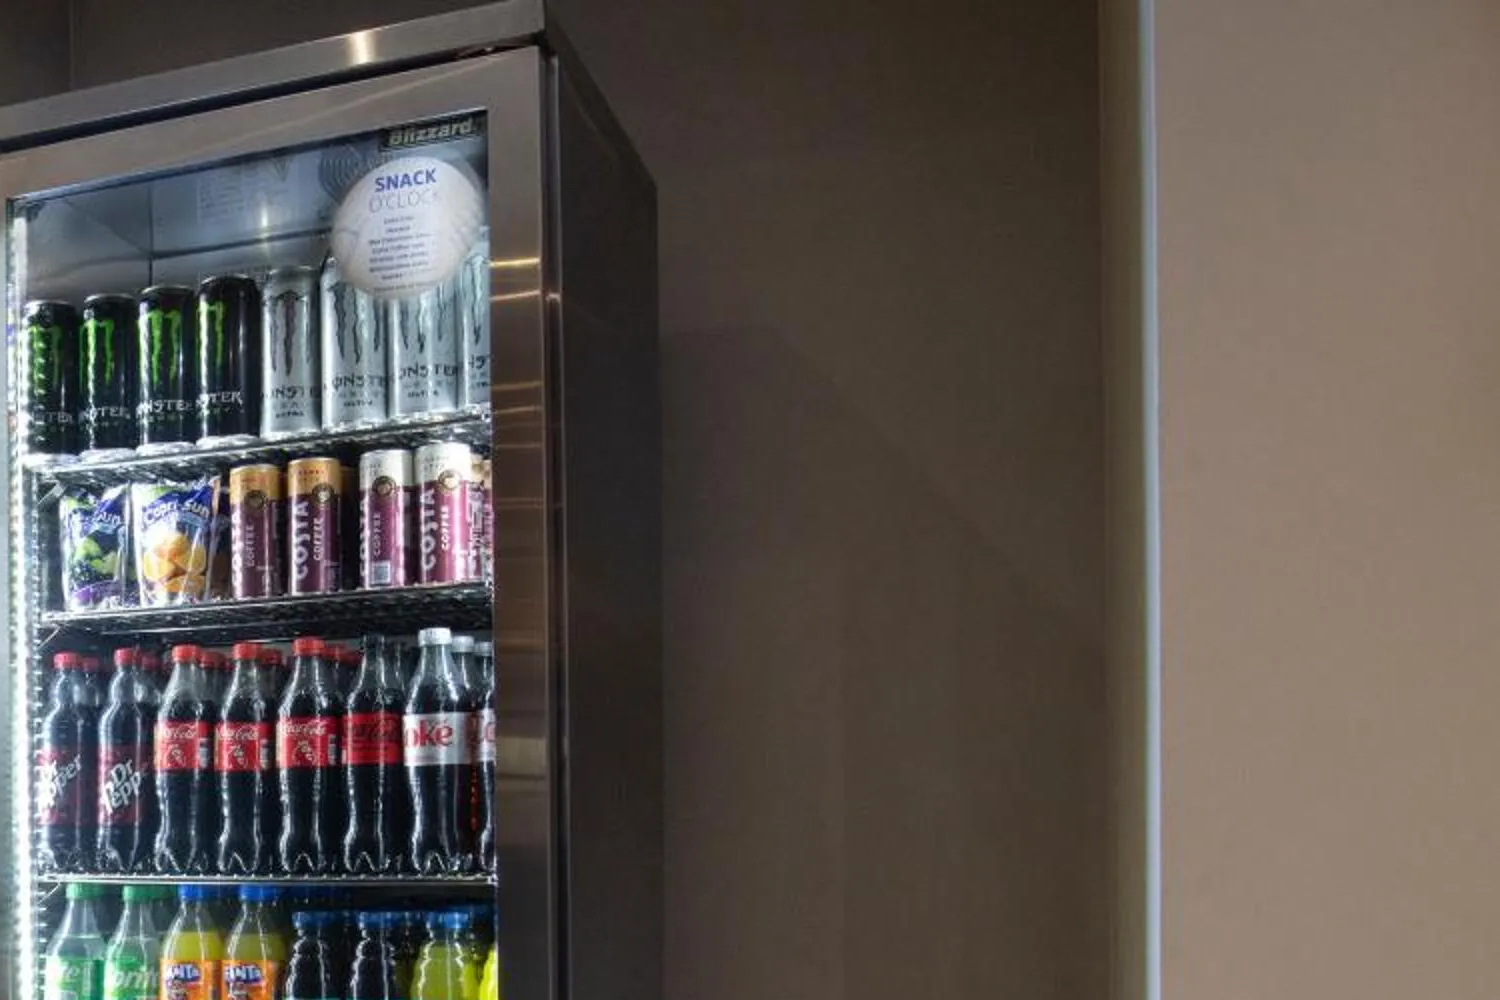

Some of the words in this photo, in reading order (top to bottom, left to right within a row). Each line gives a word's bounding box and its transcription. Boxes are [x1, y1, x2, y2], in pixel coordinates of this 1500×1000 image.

[375, 168, 437, 193] SNACK
[293, 500, 311, 581] COSTA
[312, 517, 324, 561] COFFEE
[420, 487, 438, 571] COSTA
[441, 504, 451, 552] COFFEE
[103, 768, 146, 814] Pepp
[110, 759, 133, 787] Dr
